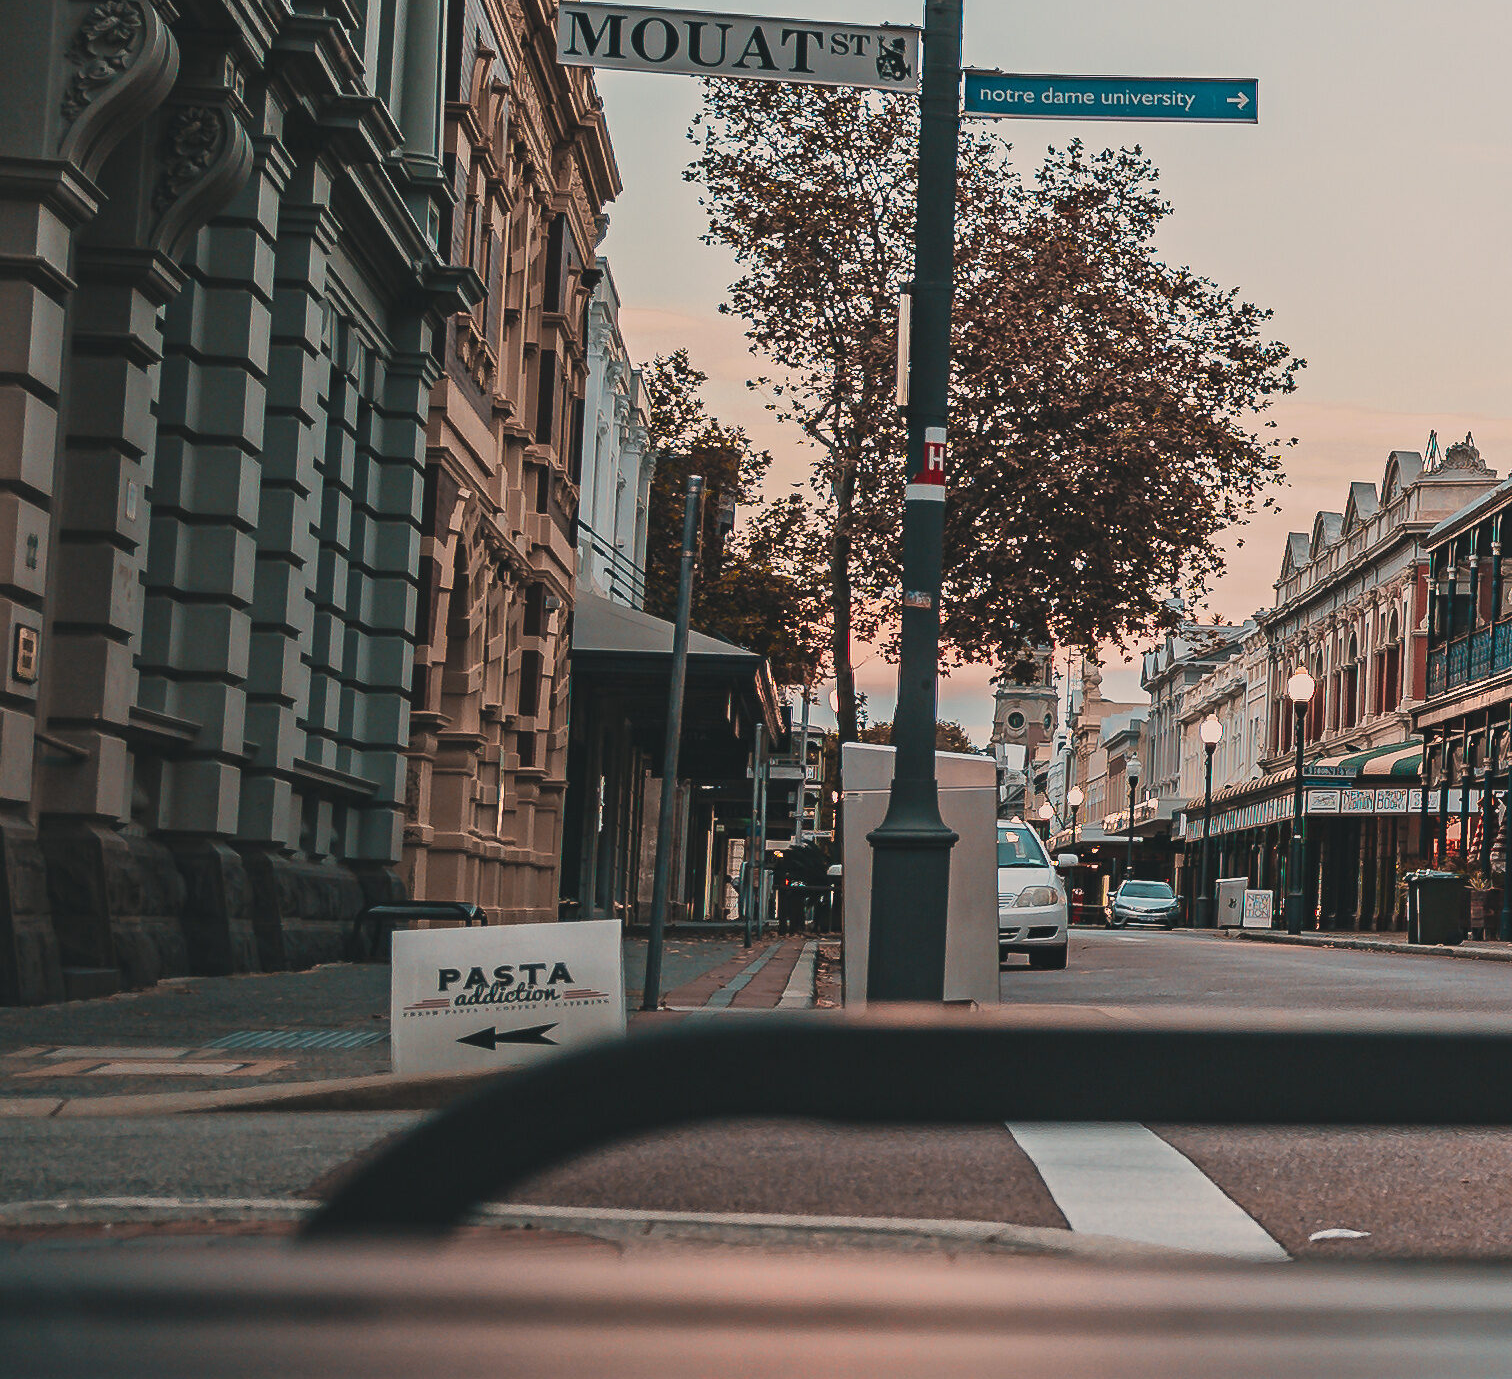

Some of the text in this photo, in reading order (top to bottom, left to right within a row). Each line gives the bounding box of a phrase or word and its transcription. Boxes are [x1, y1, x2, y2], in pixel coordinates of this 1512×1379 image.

[564, 10, 873, 73] MOUAT ST
[979, 85, 1196, 111] notre dame university
[929, 446, 944, 471] H
[438, 962, 575, 991] PASTA
[454, 982, 564, 1006] addiction
